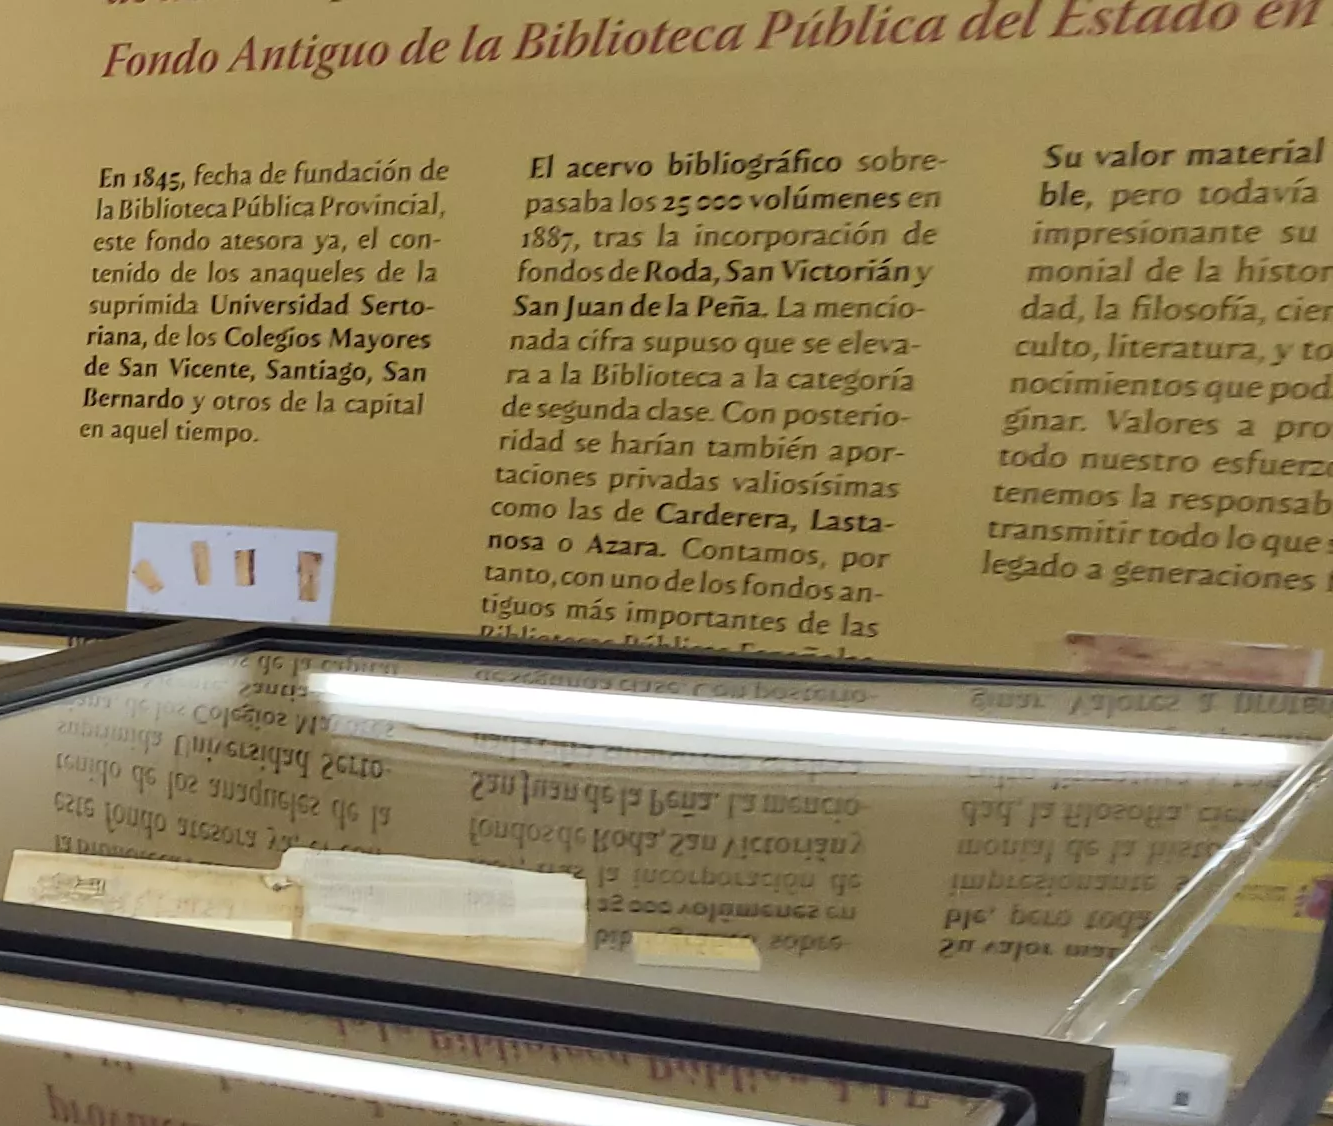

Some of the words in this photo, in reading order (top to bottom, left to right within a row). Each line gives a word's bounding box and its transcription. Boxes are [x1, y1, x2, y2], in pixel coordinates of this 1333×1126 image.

[101, 36, 220, 78] Fondo
[225, 33, 391, 81] Antiguo
[398, 25, 451, 66] de
[458, 23, 504, 64] la
[511, 16, 747, 61] Biblioteca
[754, 3, 948, 50] Pública
[957, 0, 1044, 42] del
[1047, 0, 1241, 39] Estado
[1253, 0, 1323, 30] en
[528, 153, 555, 180] El
[565, 159, 654, 179] acervo
[666, 147, 843, 182] bibliográfico
[856, 145, 947, 173] sobre-
[1042, 143, 1084, 170] Su
[1094, 139, 1178, 169] valor
[1185, 135, 1326, 167] material
[98, 167, 127, 189] En
[132, 165, 187, 193] 1845,
[193, 161, 253, 187] fecha
[258, 160, 288, 185] de
[293, 158, 412, 185] fundación
[418, 156, 450, 182] de
[95, 197, 115, 221] la
[117, 195, 228, 221] Biblioteca
[230, 193, 316, 219] Pública
[319, 190, 446, 219] Provincial,
[524, 187, 614, 220] pasaba
[618, 187, 657, 213] los
[748, 183, 902, 211] volúmenes
[906, 190, 942, 209] en
[1038, 179, 1094, 211] ble,
[1109, 187, 1182, 213] pero
[1198, 176, 1318, 206] todavía
[92, 234, 138, 253] este
[144, 227, 212, 253] fondo
[219, 233, 304, 252] atesora
[311, 233, 348, 256] ya,
[356, 225, 379, 251] el
[388, 232, 442, 250] con-
[521, 224, 581, 255] 1887,
[593, 229, 644, 249] tras
[656, 221, 680, 248] la
[693, 220, 888, 253] incorporación
[901, 219, 938, 247] de
[1032, 218, 1263, 252] impresionante
[1279, 225, 1318, 244] su
[91, 259, 162, 285] tenido
[169, 259, 198, 284] de
[206, 259, 240, 284] los
[249, 258, 366, 289] anaqueles
[375, 258, 406, 284] de
[416, 258, 438, 284] la
[516, 257, 605, 284] fondos
[607, 257, 641, 283] de
[642, 257, 721, 288] Roda,
[722, 258, 775, 284] San
[780, 256, 911, 283] Victorián
[911, 265, 933, 289] y
[1026, 256, 1134, 283] monial
[1144, 255, 1184, 283] de
[1194, 255, 1222, 283] la
[88, 290, 200, 321] suprimida
[210, 291, 351, 316] Universidad
[359, 293, 435, 317] Serto-
[512, 293, 560, 318] San
[561, 294, 625, 323] Juan
[628, 292, 663, 318] de
[665, 292, 690, 319] la
[695, 294, 770, 319] Peña.
[775, 294, 807, 319] La
[813, 294, 925, 320] mencio-
[85, 324, 149, 351] riana,
[153, 322, 181, 348] de
[185, 323, 218, 348] los
[223, 323, 323, 354] Colegios
[327, 326, 432, 355] Mayores
[83, 353, 111, 377] de
[117, 356, 159, 378] San
[168, 356, 256, 384] Vicente,
[264, 358, 373, 387] Santiago,
[381, 360, 427, 383] San
[1009, 369, 1199, 398] nocimientos
[1203, 380, 1264, 404] que
[82, 386, 185, 410] Bernardo
[189, 395, 206, 416] y
[211, 393, 272, 412] otros
[279, 388, 308, 413] de
[315, 389, 336, 414] la
[343, 391, 425, 420] capital
[79, 423, 105, 439] en
[110, 417, 169, 445] aquel
[175, 419, 259, 448] tiempo.
[993, 484, 1120, 508] tenemos
[1129, 482, 1156, 509] la
[981, 548, 1079, 582] legado
[1085, 562, 1103, 581] a
[1111, 560, 1316, 592] generaciones
